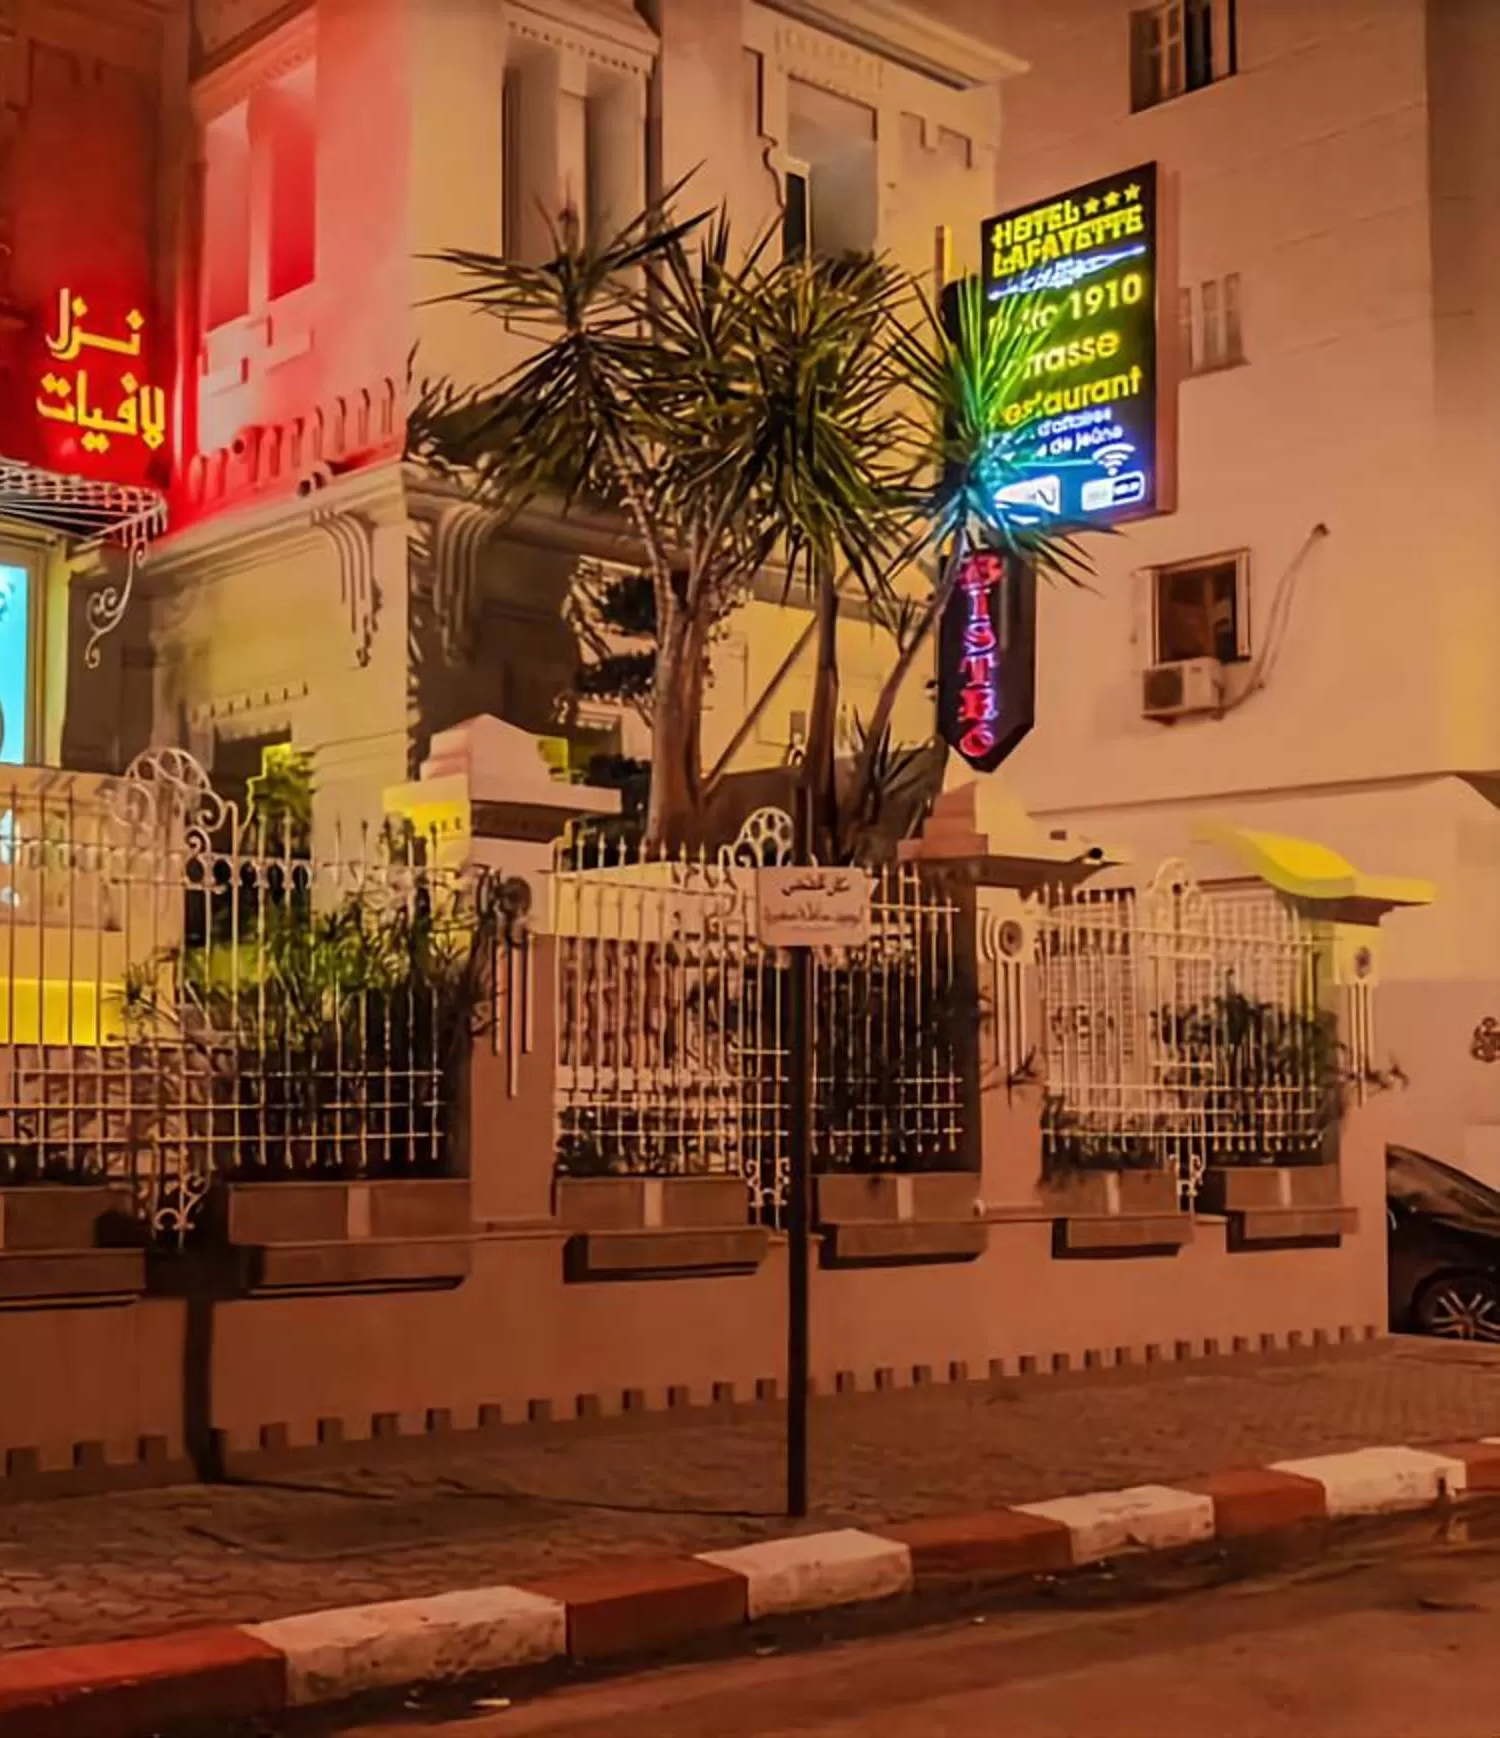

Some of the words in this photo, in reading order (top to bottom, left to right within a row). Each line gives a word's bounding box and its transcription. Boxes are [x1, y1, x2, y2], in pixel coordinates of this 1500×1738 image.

[991, 200, 1081, 248] HOTEL
[993, 203, 1144, 279] LAFAYETTE
[46, 287, 141, 360] نزل
[1070, 272, 1143, 320] 1910
[36, 371, 165, 453] لافيات
[958, 551, 1003, 758] BISTRO
